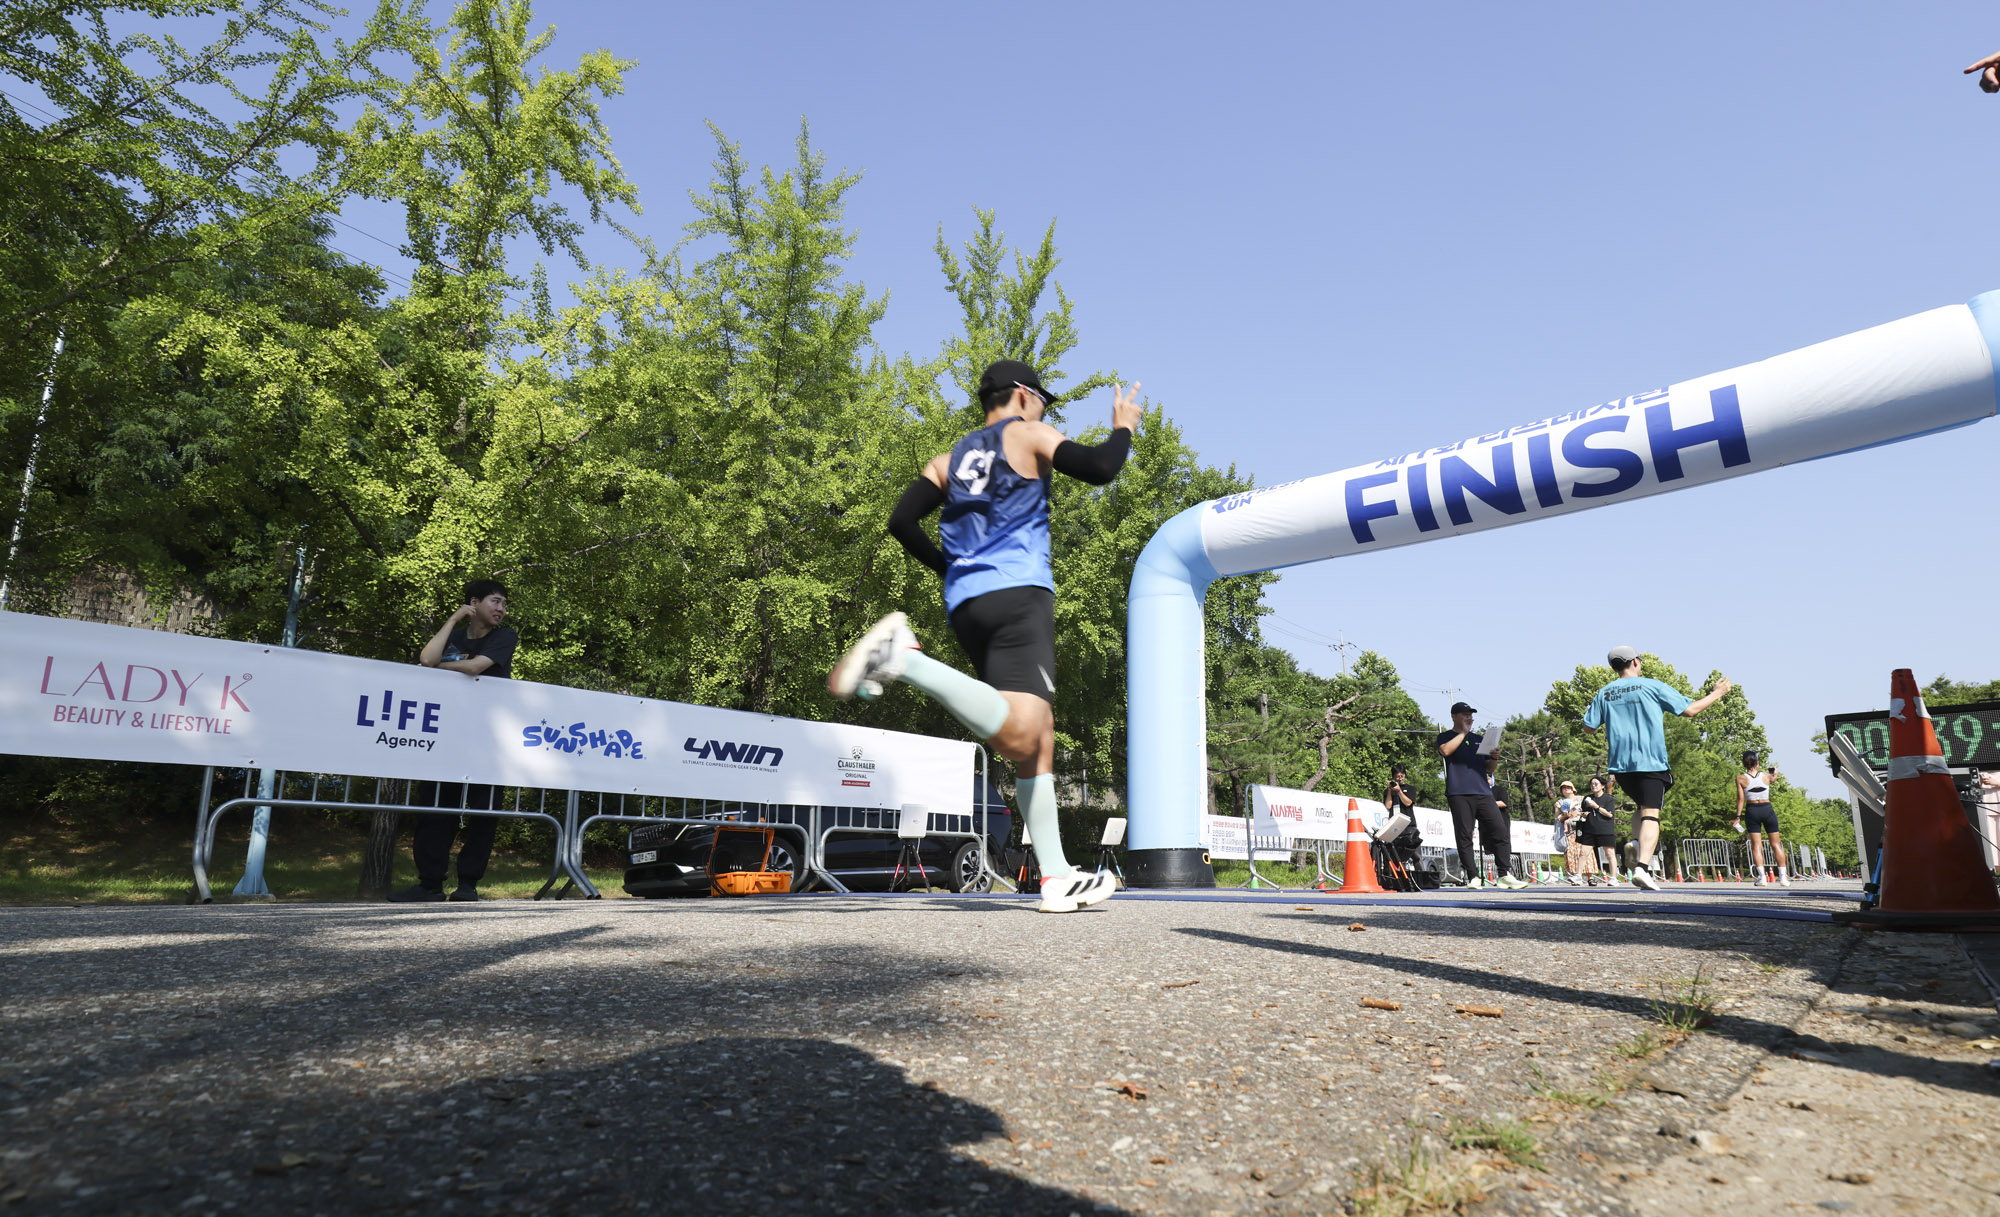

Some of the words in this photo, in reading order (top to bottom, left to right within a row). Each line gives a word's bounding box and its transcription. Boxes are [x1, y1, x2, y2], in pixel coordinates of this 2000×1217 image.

[1345, 383, 1751, 544] FINISH
[40, 655, 204, 708] LADY
[53, 704, 127, 726] BEAUTY
[131, 711, 144, 728] &
[150, 713, 233, 735] LIFESTYLE
[375, 731, 436, 752] Agency
[522, 720, 644, 760] SUNSHADE
[705, 761, 737, 769] COMPRESSION
[837, 759, 876, 770] CLAUSTHALER
[1270, 804, 1303, 822] 시사저널
